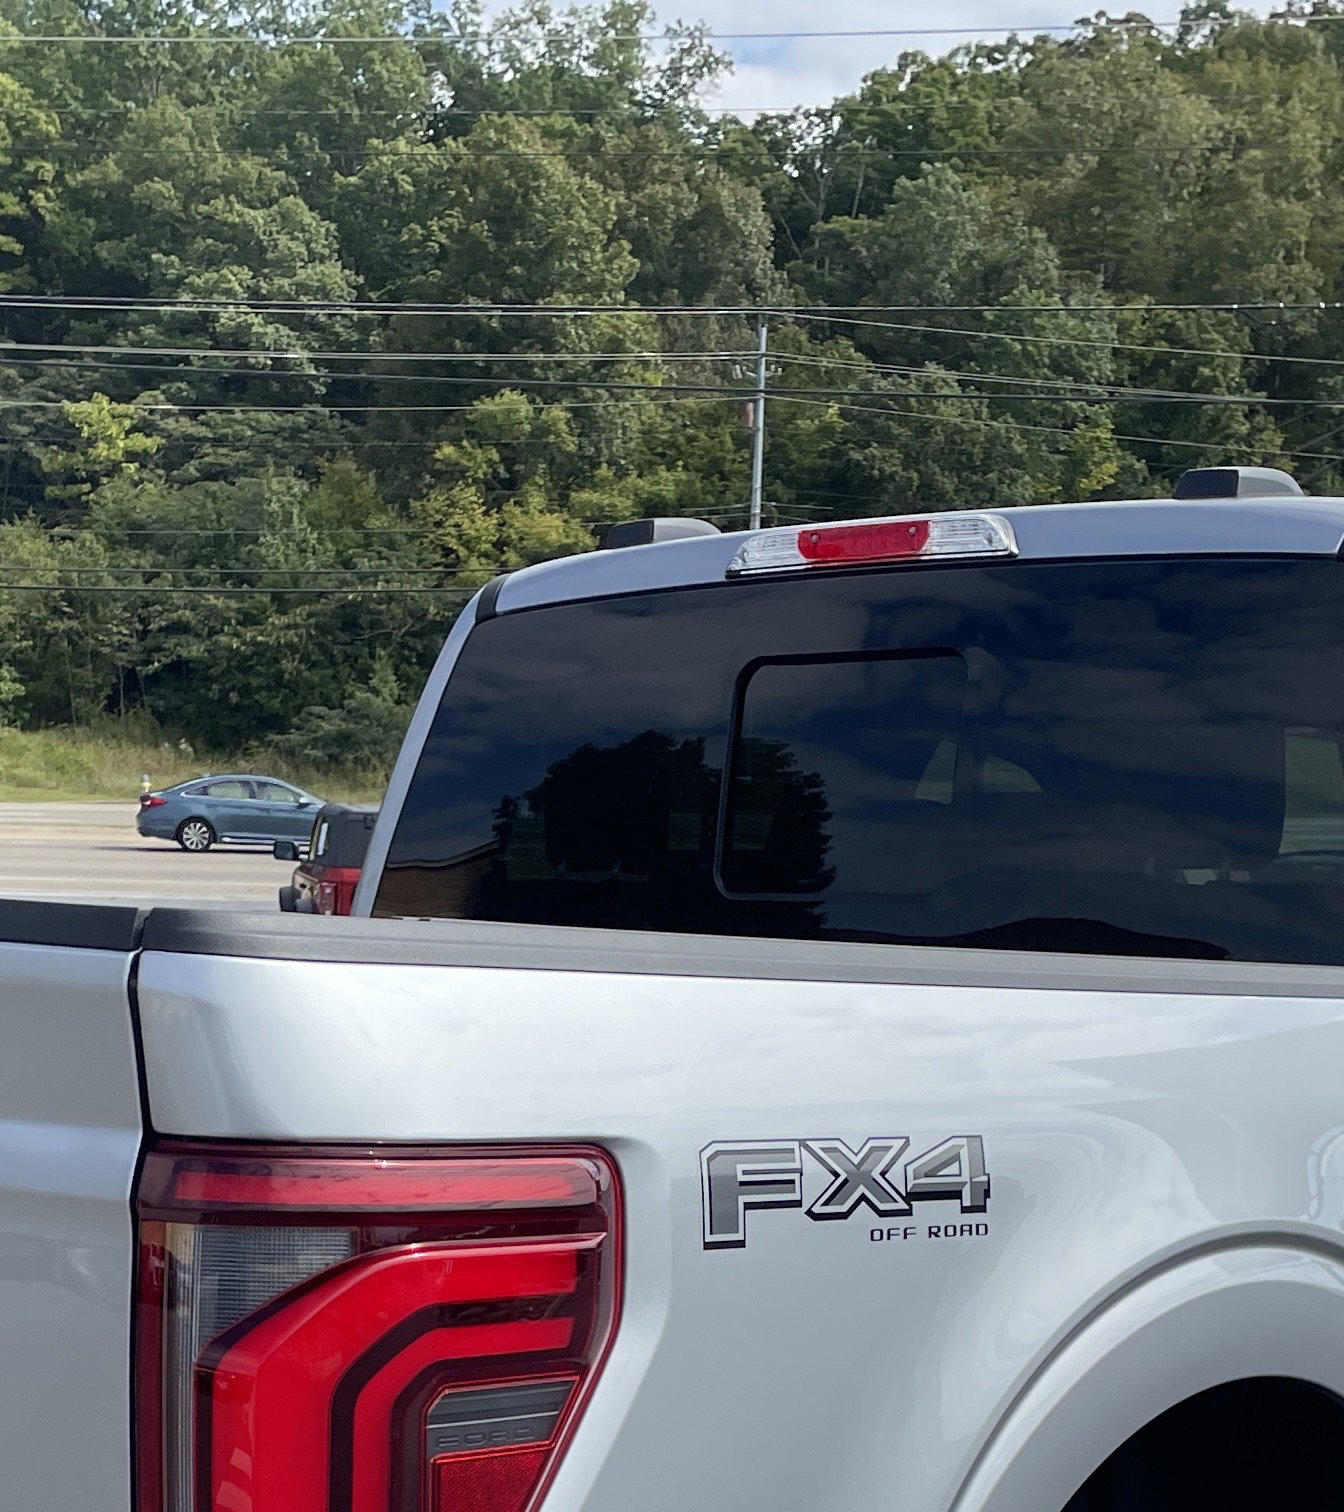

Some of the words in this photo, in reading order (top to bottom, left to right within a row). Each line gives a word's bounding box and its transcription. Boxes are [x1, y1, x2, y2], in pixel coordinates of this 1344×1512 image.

[699, 1134, 991, 1250] FX4
[869, 1225, 917, 1242] OFF
[927, 1222, 989, 1240] ROAD
